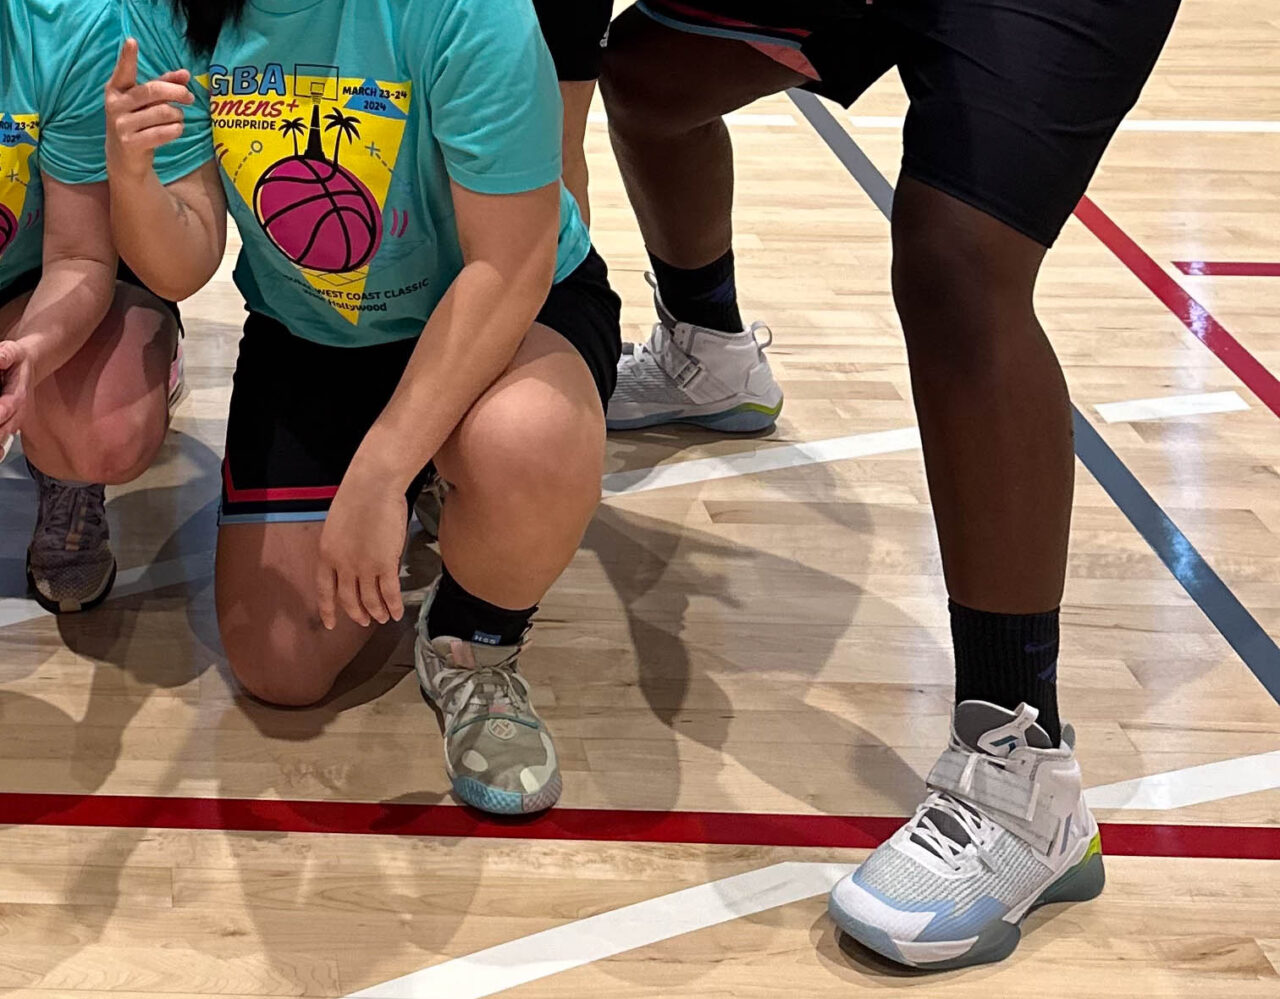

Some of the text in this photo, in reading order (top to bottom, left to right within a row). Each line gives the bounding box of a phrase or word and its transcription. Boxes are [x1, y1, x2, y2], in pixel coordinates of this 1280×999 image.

[209, 63, 286, 96] GBA
[342, 86, 408, 100] MARCH 23-24
[210, 99, 299, 118] omens+
[363, 101, 387, 112] 2024
[213, 119, 276, 130] YOURPRIDE
[346, 291, 381, 301] COAST
[384, 278, 430, 299] CLASSIC
[328, 300, 387, 312] Hollywood
